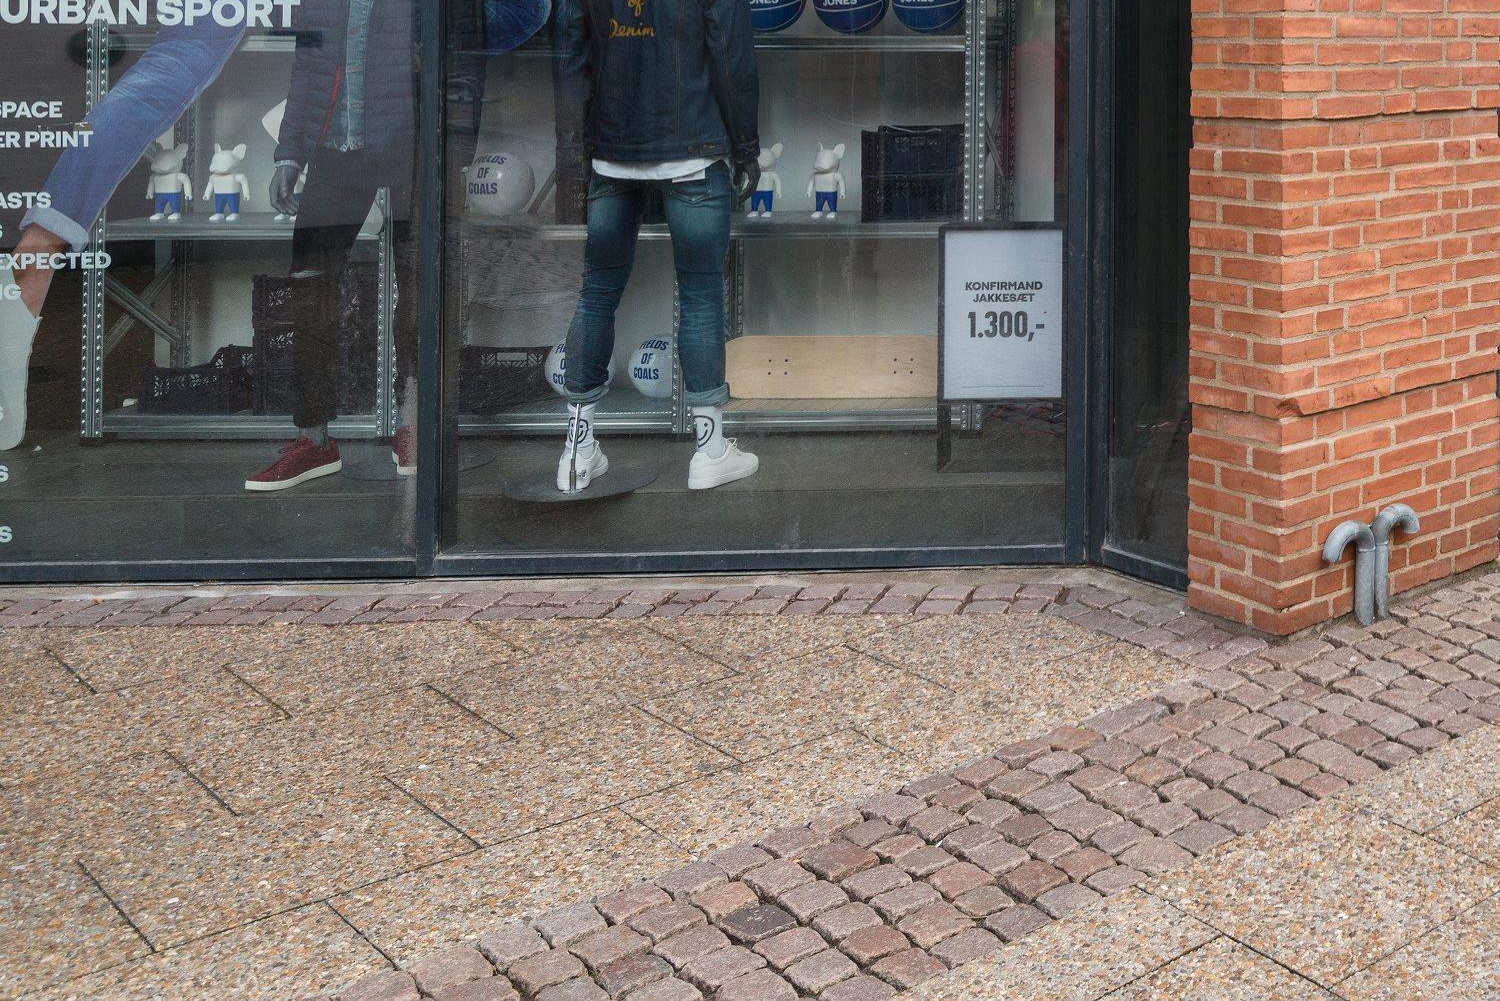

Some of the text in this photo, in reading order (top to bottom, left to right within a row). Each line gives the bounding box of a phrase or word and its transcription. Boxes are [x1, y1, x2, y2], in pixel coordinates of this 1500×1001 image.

[608, 16, 656, 40] Denim
[0, 101, 63, 118] PACE
[25, 131, 93, 148] PRINT
[477, 167, 490, 179] OF
[468, 182, 498, 195] GOALS
[965, 281, 1043, 291] KONFIRMAND
[973, 293, 1036, 303] JAKKESÆT
[967, 310, 1045, 342] 1.300,-
[640, 339, 669, 351] FIELDS
[641, 353, 654, 365] OF
[633, 367, 660, 380] GOALS
